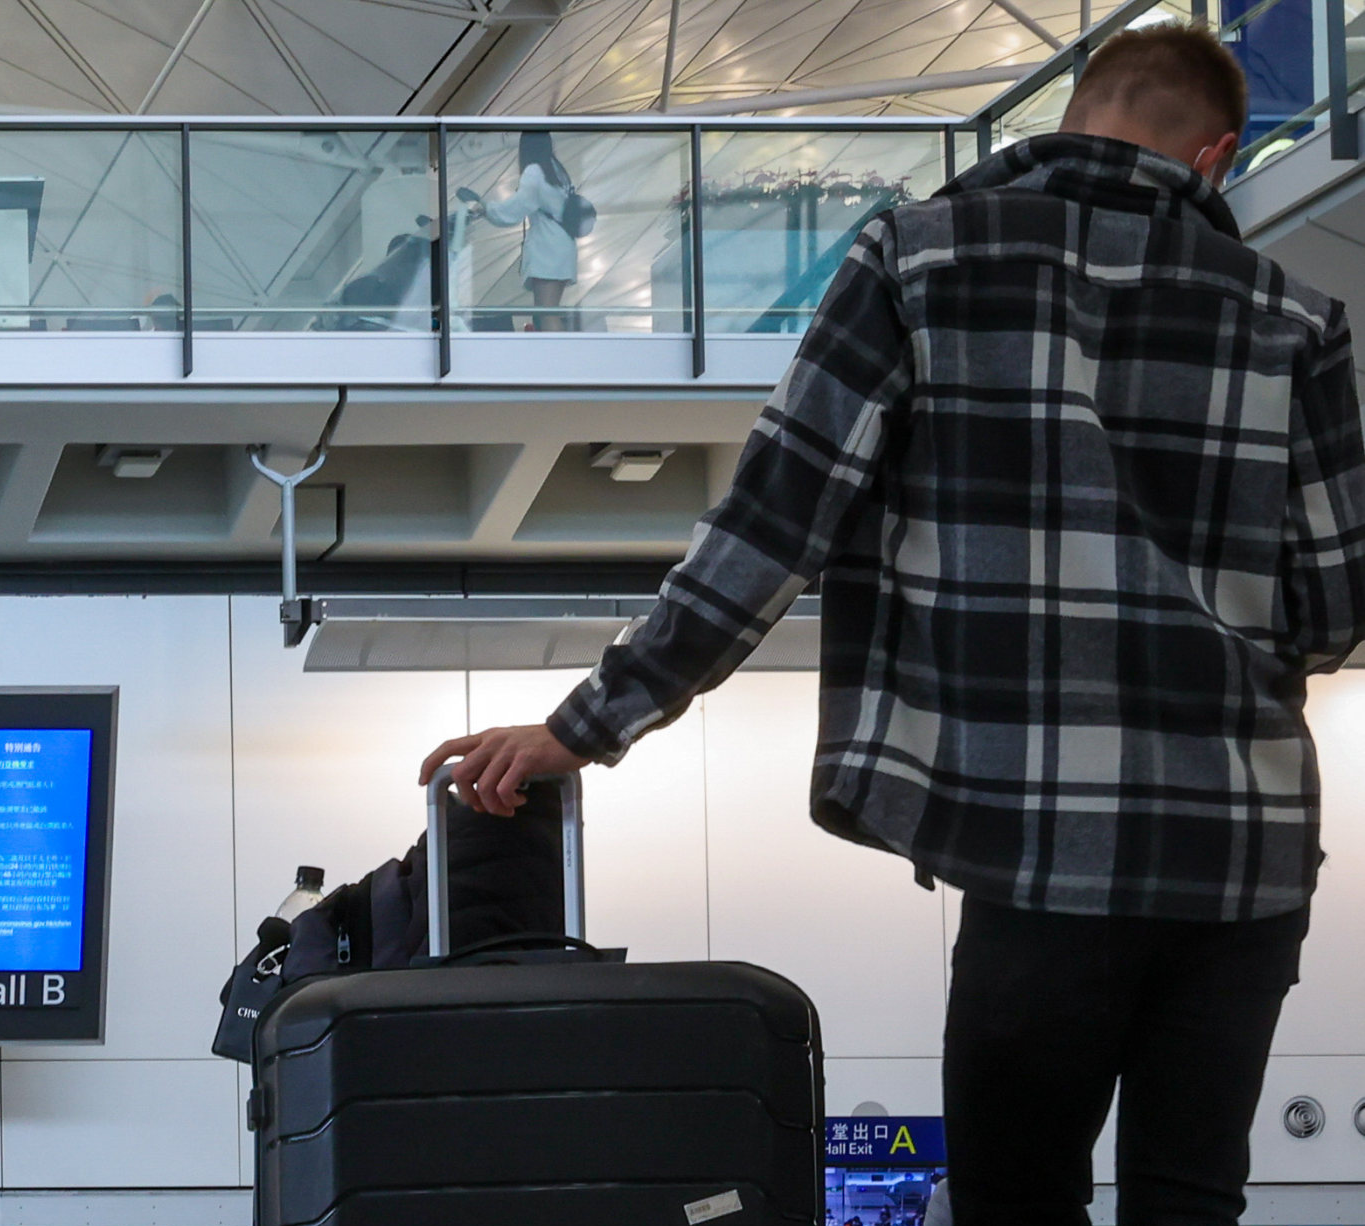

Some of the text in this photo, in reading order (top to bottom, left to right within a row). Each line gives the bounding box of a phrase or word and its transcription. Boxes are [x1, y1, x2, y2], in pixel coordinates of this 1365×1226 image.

[42, 974, 65, 1004] B
[824, 1122, 889, 1141] 堂出口
[889, 1125, 917, 1155] A
[848, 1142, 873, 1156] Exit
